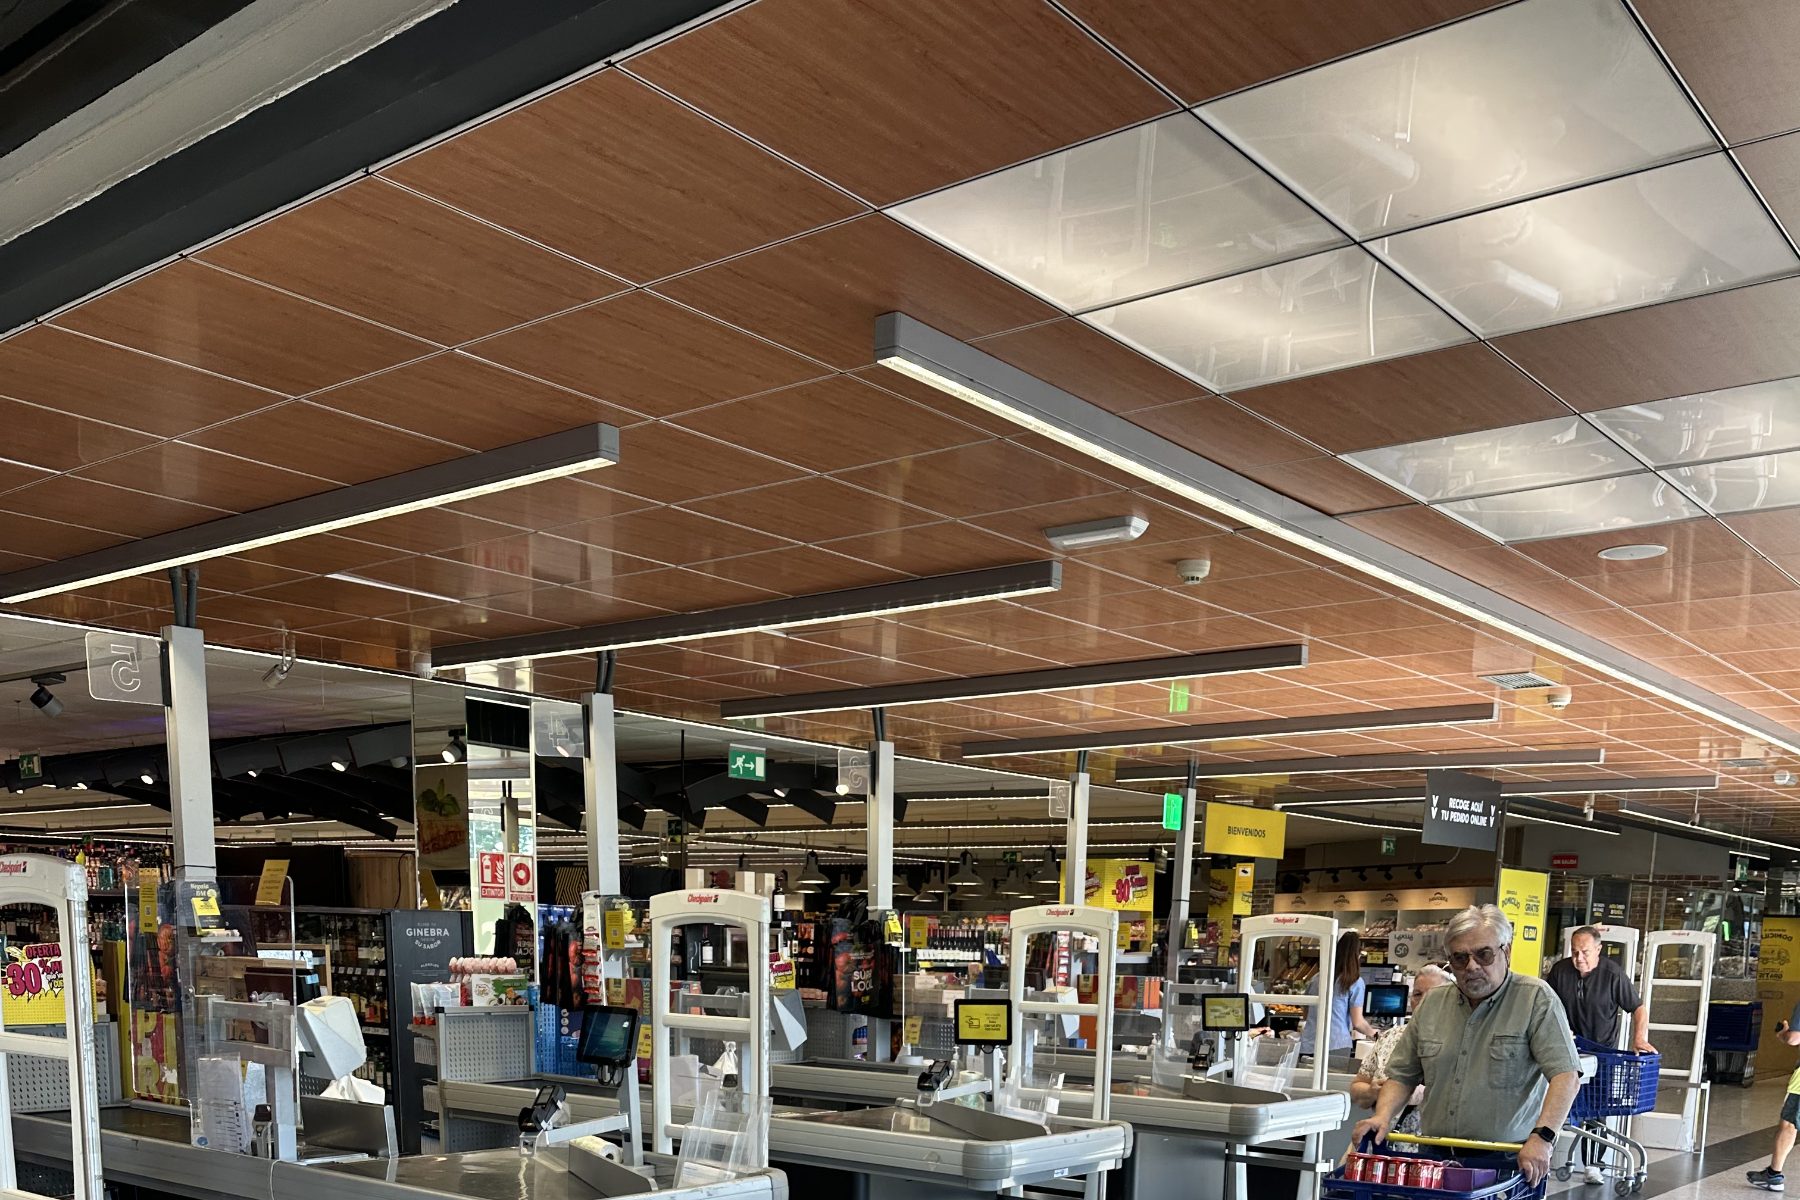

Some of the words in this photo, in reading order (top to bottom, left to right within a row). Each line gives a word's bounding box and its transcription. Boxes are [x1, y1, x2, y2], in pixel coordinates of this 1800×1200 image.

[1448, 797, 1471, 811] RECOGE
[1470, 800, 1484, 813] AQUÍ
[1441, 809, 1450, 821] TU
[1450, 811, 1470, 824] PEDIDO
[1470, 814, 1488, 827] ONLINE
[1227, 825, 1266, 838] BIENVENIDOS
[481, 887, 505, 897] EXTINTOR
[687, 894, 713, 905] Checkpoint
[405, 927, 450, 938] GINEBRA
[25, 943, 61, 959] OFERTA
[422, 940, 441, 950] SABOR
